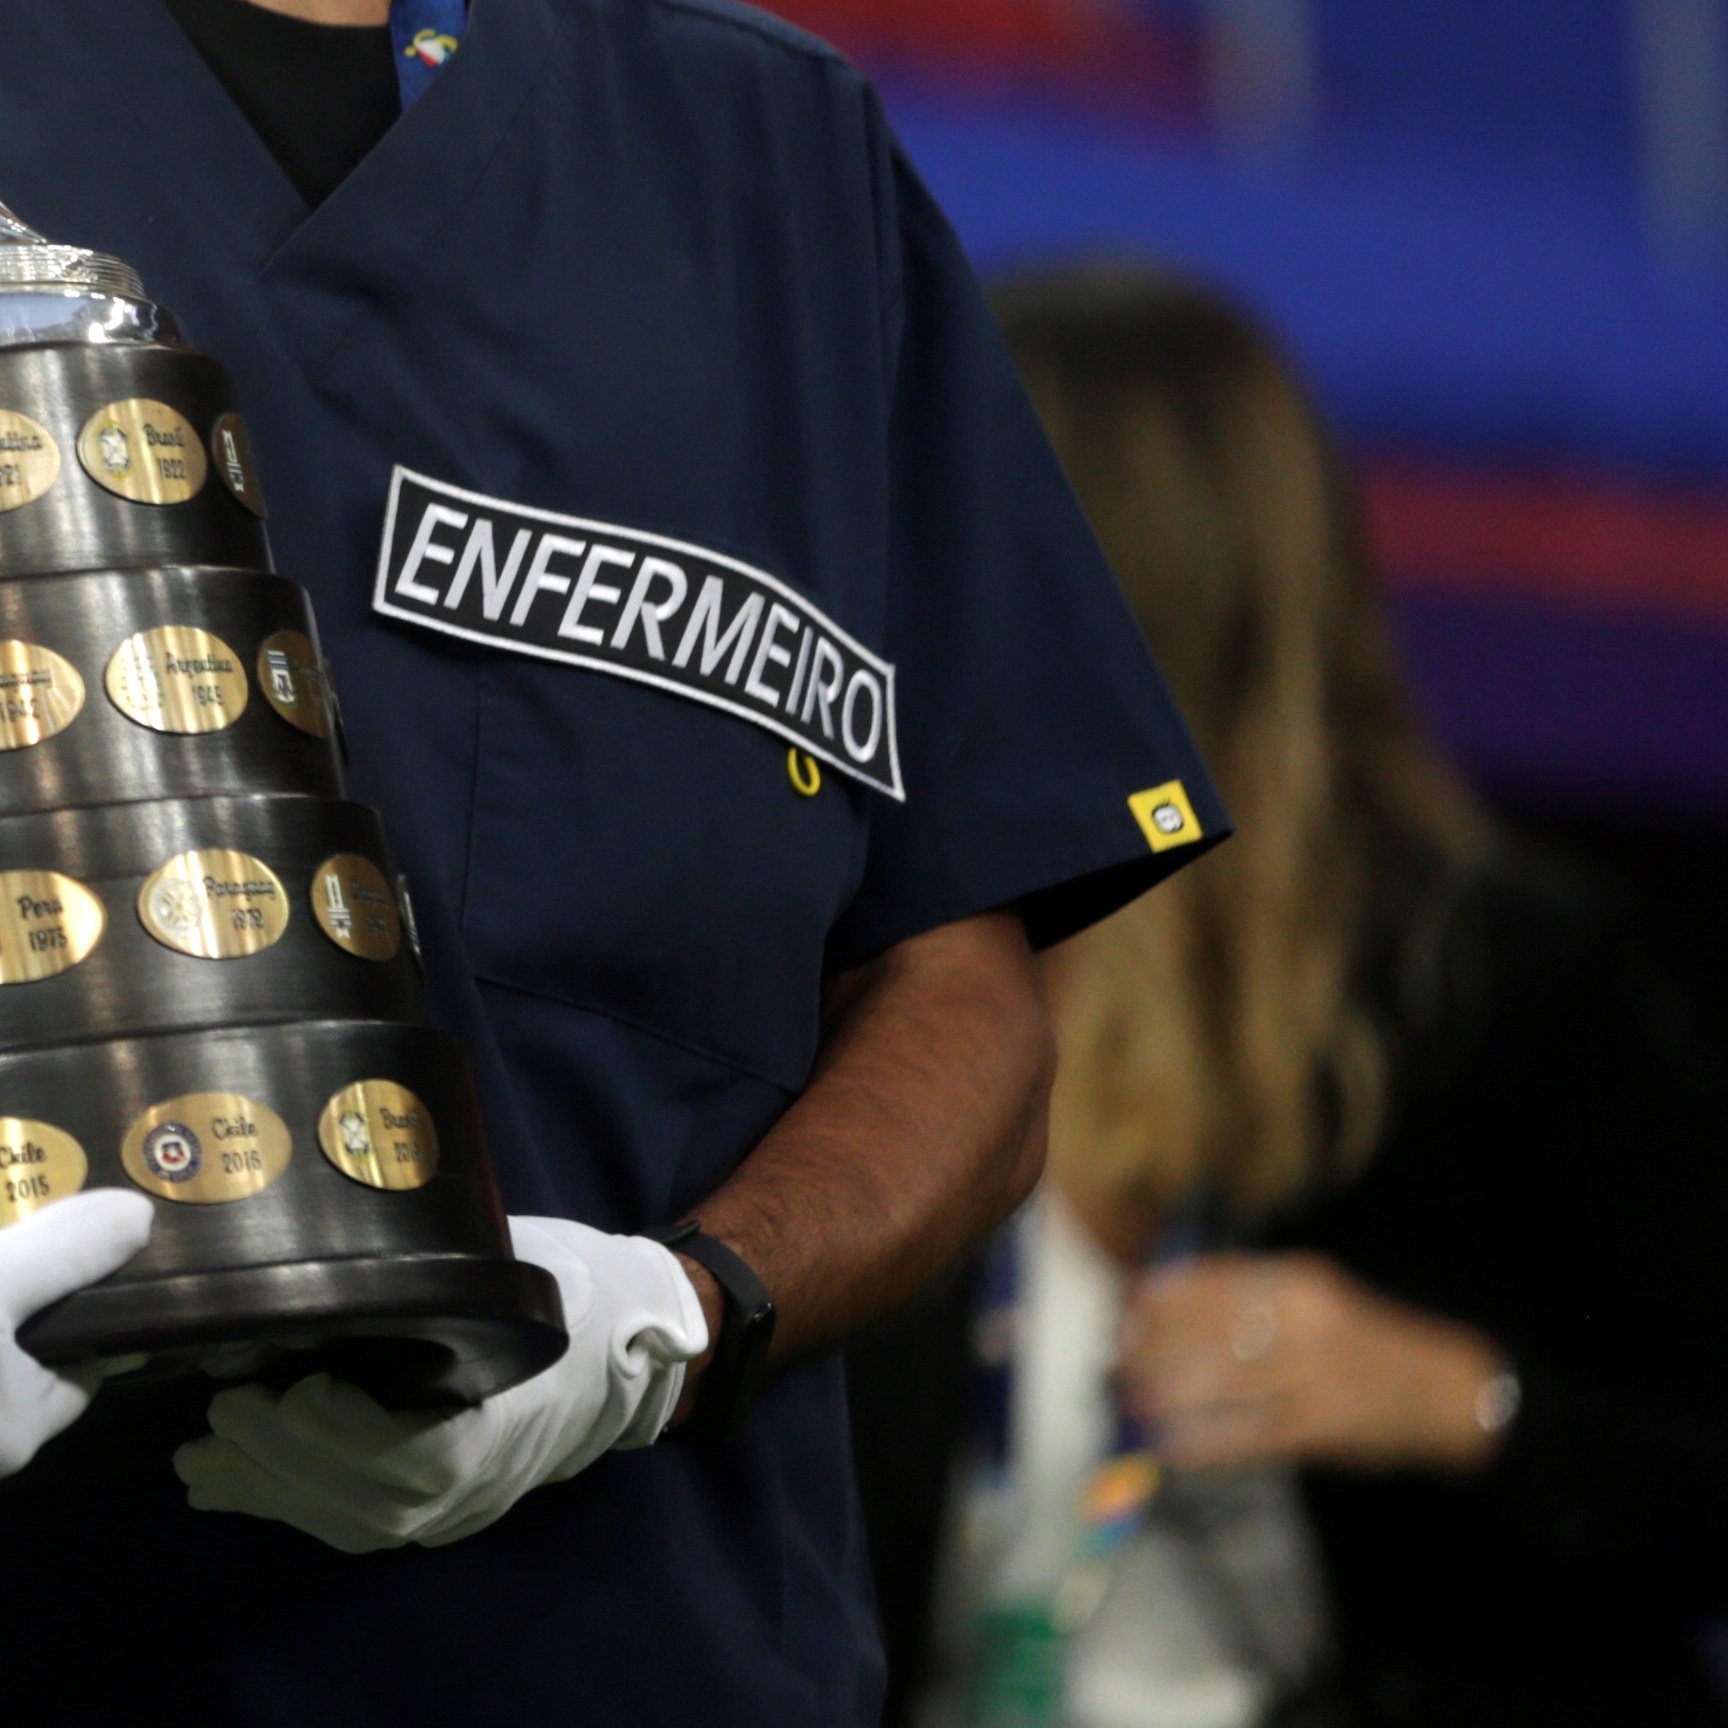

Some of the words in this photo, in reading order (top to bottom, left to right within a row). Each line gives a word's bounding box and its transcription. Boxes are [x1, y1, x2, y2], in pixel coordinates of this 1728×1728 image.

[143, 423, 185, 448] Brasil
[157, 459, 185, 480] 1922
[393, 501, 884, 764] ENFERMEIRO
[211, 1115, 258, 1140] Chile
[6, 1175, 50, 1203] 2015
